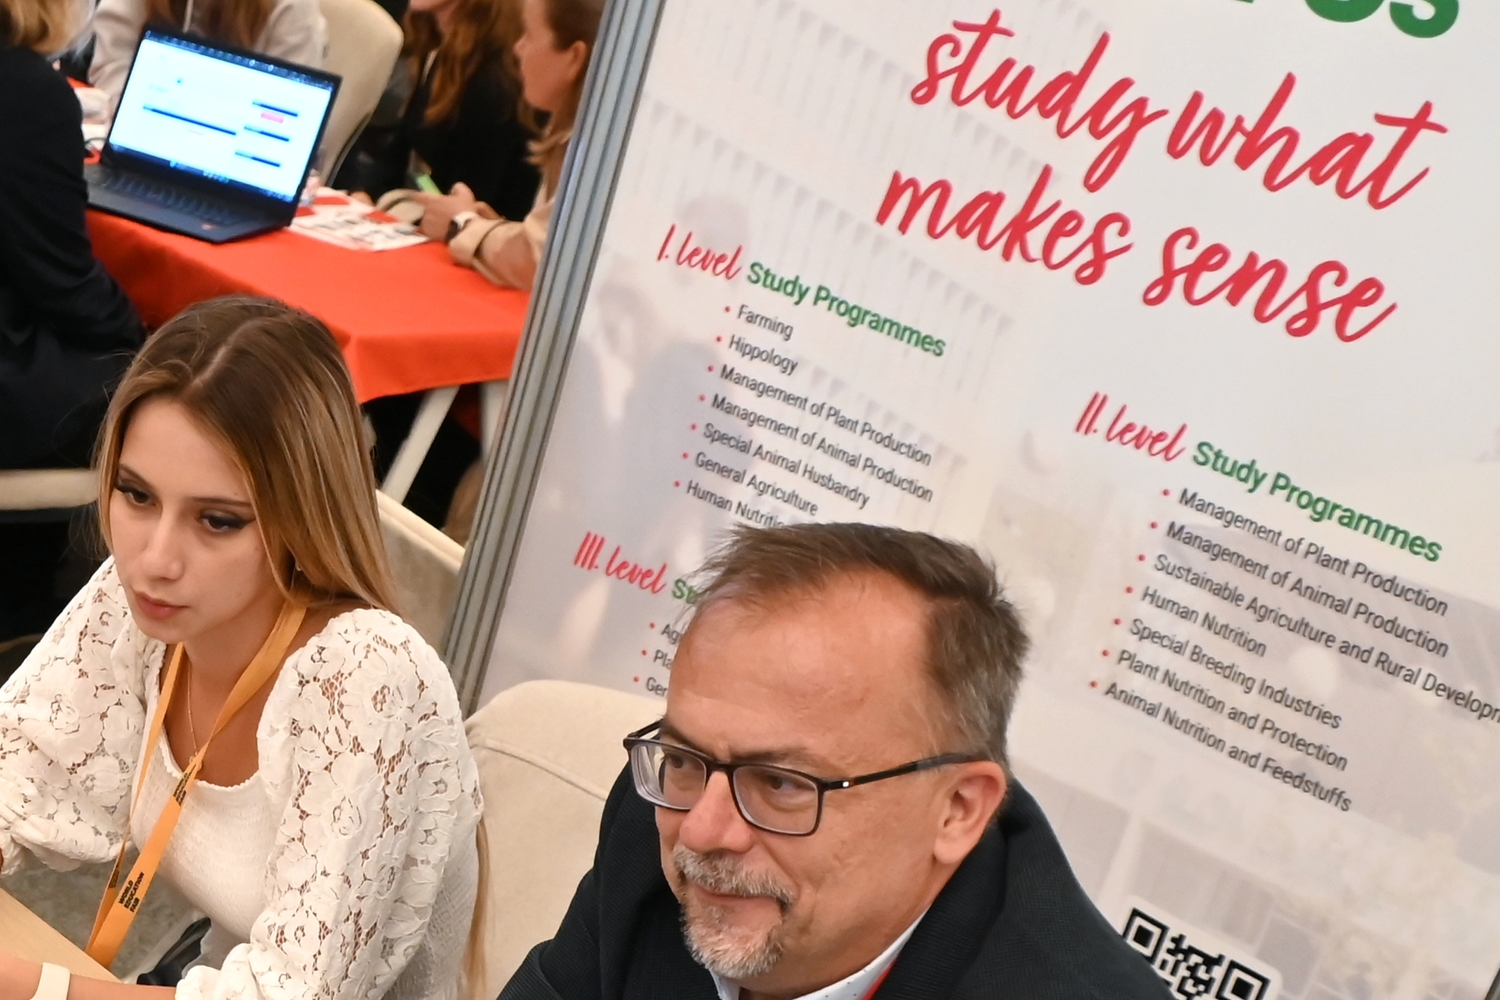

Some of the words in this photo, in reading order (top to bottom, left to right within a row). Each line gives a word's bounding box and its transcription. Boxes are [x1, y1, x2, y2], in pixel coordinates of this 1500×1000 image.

[910, 8, 1169, 193] study
[1167, 72, 1449, 210] what
[675, 231, 743, 280] level
[747, 261, 811, 305] Study
[812, 285, 947, 357] Programmes
[875, 164, 1134, 286] makes
[1142, 226, 1398, 344] sense
[728, 334, 798, 376] Hippology
[737, 304, 794, 342] Farming
[703, 422, 753, 455] Special
[753, 443, 801, 475] Animal
[802, 462, 870, 510] Husbandry
[711, 394, 799, 440] Management
[802, 431, 817, 446] of
[817, 437, 860, 469] Animal
[862, 457, 933, 503] Production
[720, 364, 808, 411] Management
[810, 402, 826, 417] of
[826, 406, 859, 434] Plant
[860, 422, 932, 466] Production
[687, 480, 733, 511] Human
[695, 451, 746, 483] General
[746, 477, 819, 517] Agriculture
[1105, 403, 1188, 462] level
[1193, 441, 1268, 494] Study
[1269, 471, 1443, 563] Programmes
[605, 545, 668, 594] level
[1167, 521, 1270, 581] Management
[1271, 570, 1291, 588] of
[1289, 577, 1354, 615] Animal
[1355, 602, 1449, 659] Production
[1179, 488, 1282, 547] Management
[1285, 537, 1305, 554] of
[1304, 542, 1351, 576] Plant
[1352, 561, 1449, 617] Production
[1141, 585, 1200, 625] Human
[1200, 611, 1267, 658] Nutrition
[1154, 553, 1246, 608] Sustainable
[1246, 595, 1337, 648] Agriculture
[1339, 641, 1371, 664] and
[1374, 650, 1422, 686] Rural
[1117, 649, 1160, 681] Plant
[1161, 668, 1226, 714] Nutrition
[1228, 707, 1260, 730] and
[1260, 718, 1348, 772] Protection
[1130, 618, 1190, 656] Special
[1189, 644, 1256, 695] Breeding
[1257, 678, 1342, 730] Industries
[1104, 682, 1163, 719] Animal
[1162, 707, 1226, 753] Nutrition
[1228, 745, 1261, 769] and
[1261, 756, 1353, 813] Feedstuffs
[118, 880, 134, 905] WORLD
[124, 872, 145, 909] EDUCATION
[130, 897, 140, 913] FAIR
